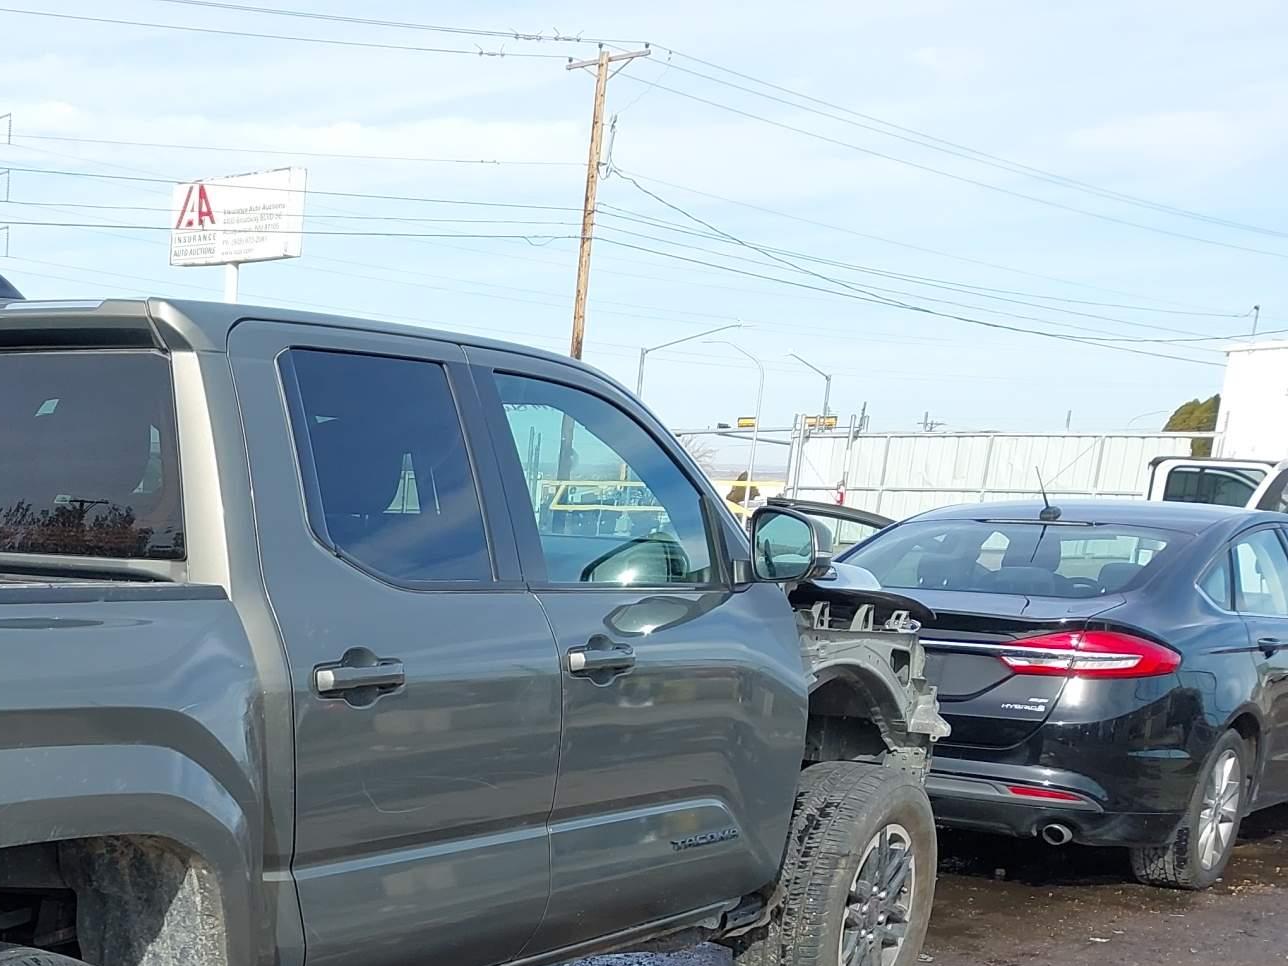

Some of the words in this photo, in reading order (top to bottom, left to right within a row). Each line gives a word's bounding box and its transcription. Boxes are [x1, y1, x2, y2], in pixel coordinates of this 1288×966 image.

[174, 232, 217, 245] INSURANCE
[173, 248, 188, 258] AUTO
[189, 246, 216, 257] AUCTIONS
[670, 828, 740, 851] TACOMA
